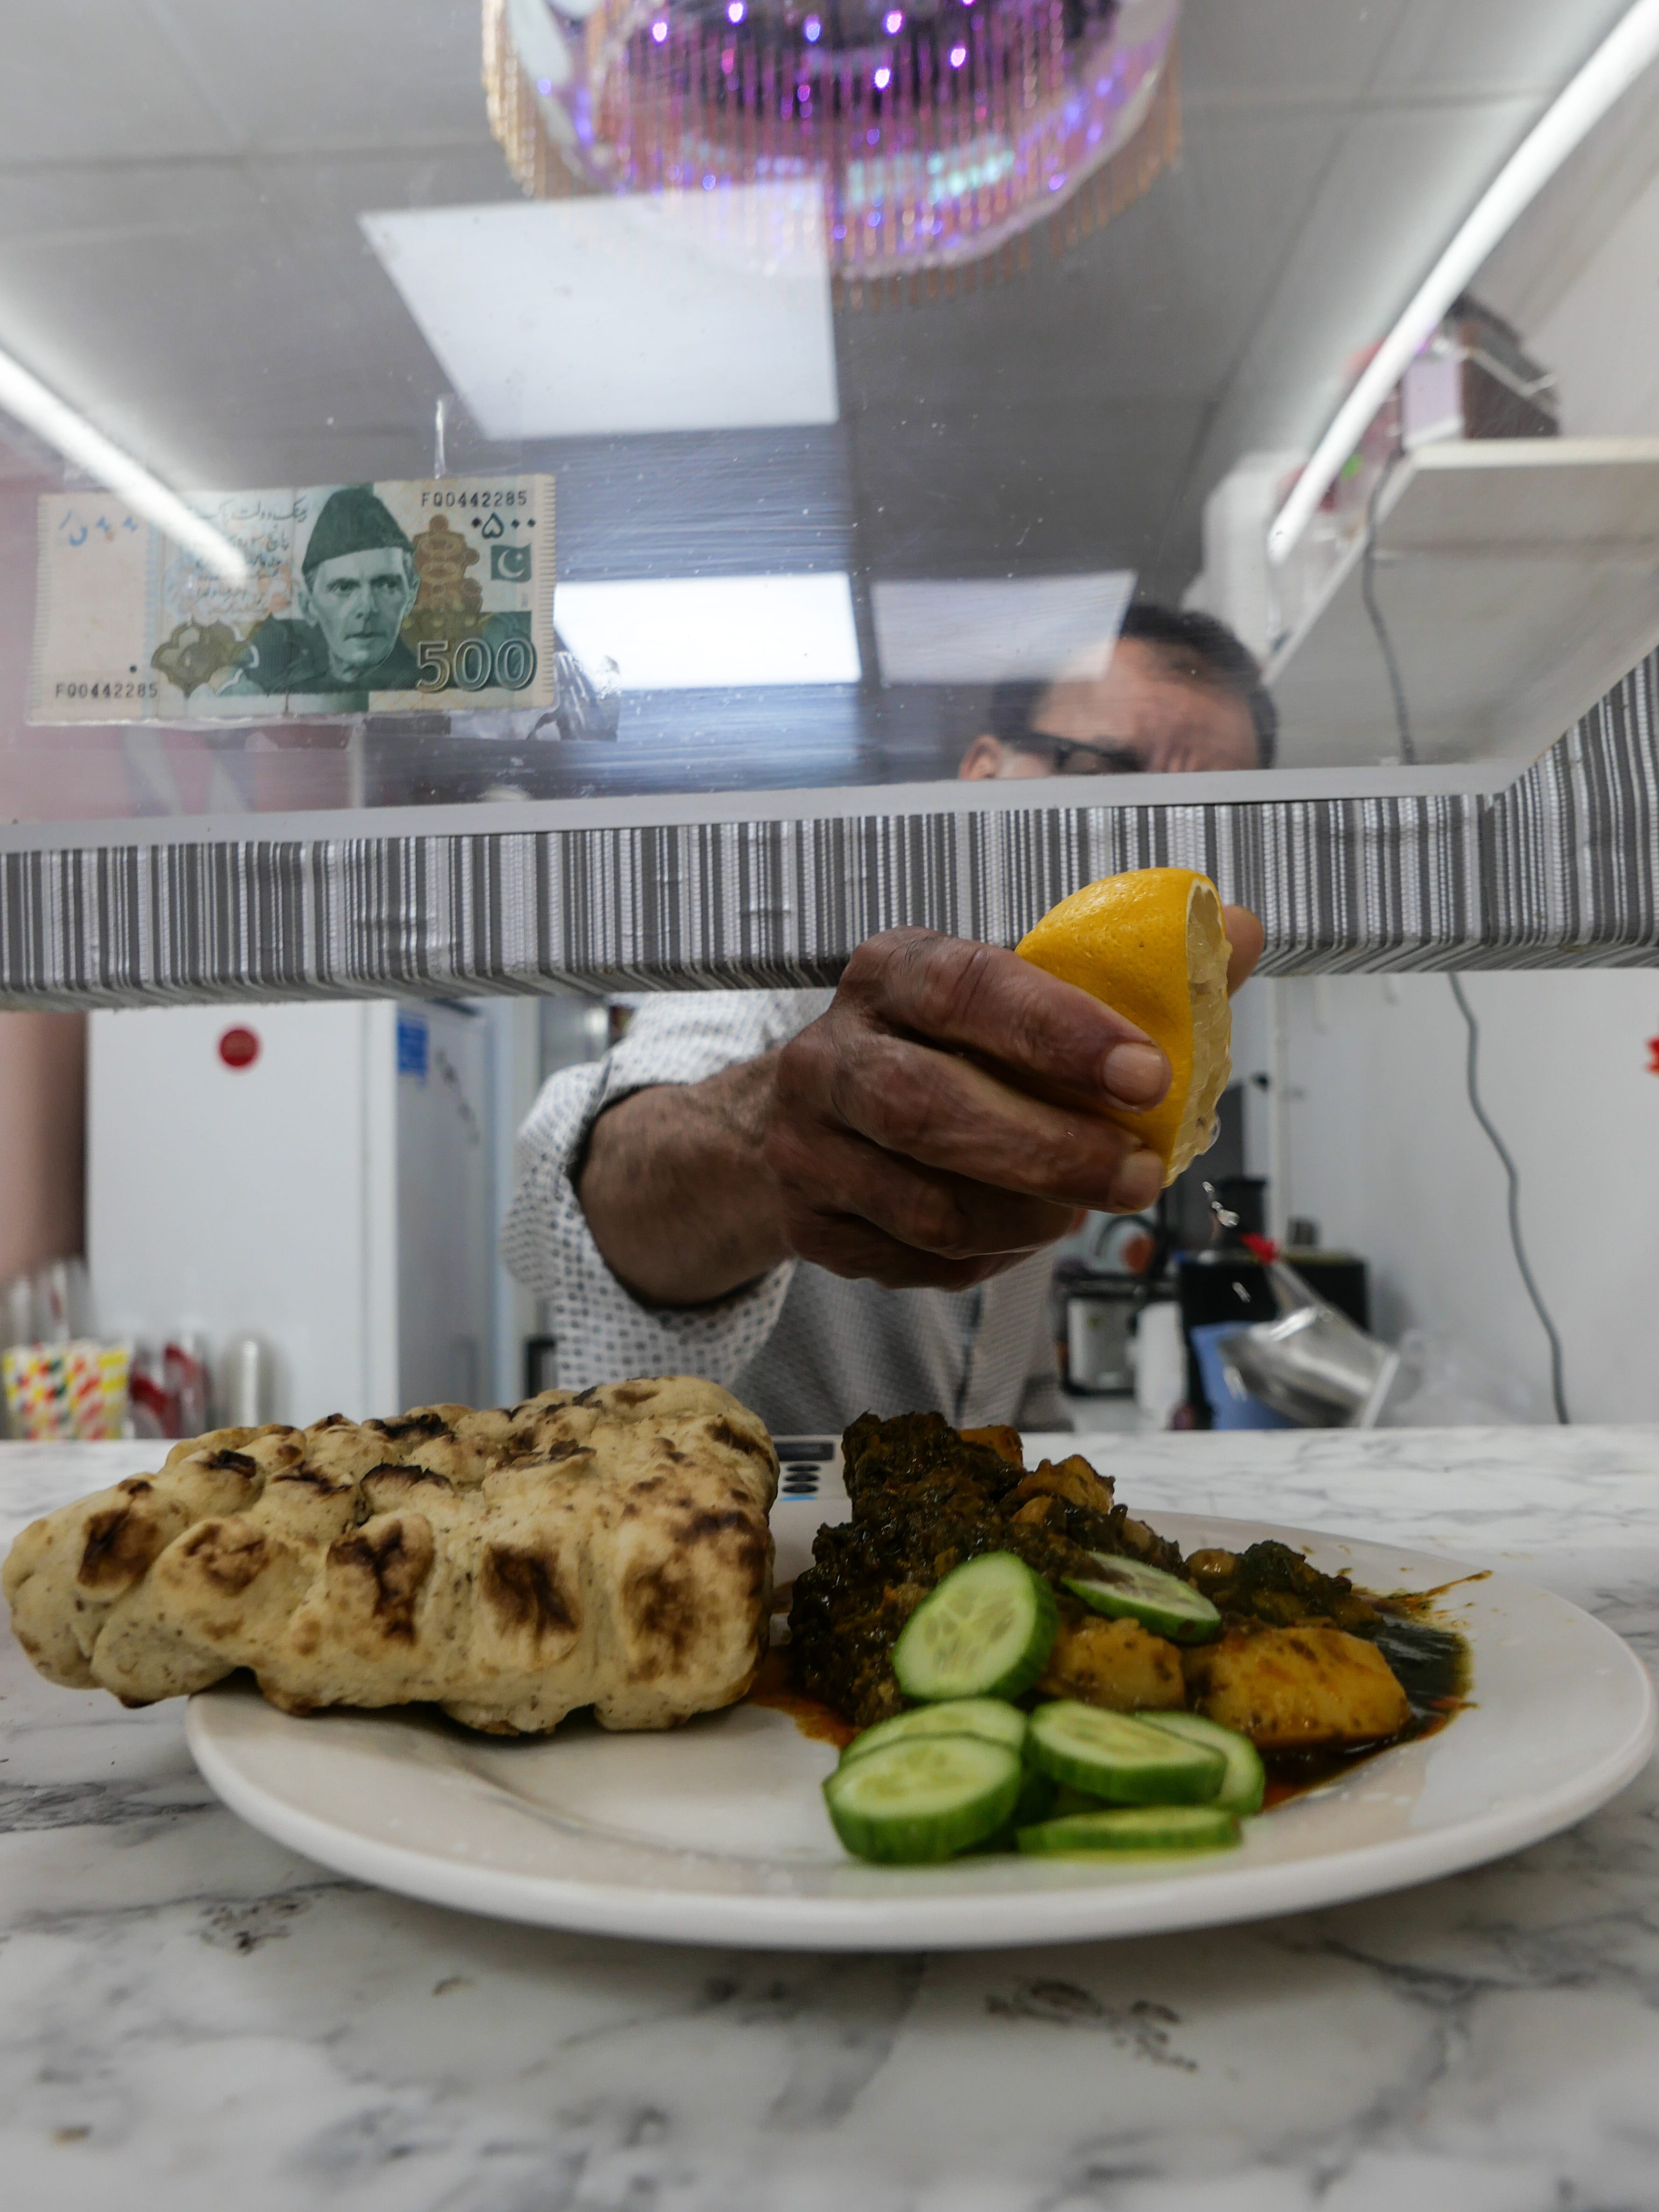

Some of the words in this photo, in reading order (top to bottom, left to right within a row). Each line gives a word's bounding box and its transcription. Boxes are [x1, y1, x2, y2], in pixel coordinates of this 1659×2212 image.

[421, 490, 527, 508] FQ0442285
[416, 638, 537, 694] 500
[55, 682, 158, 699] FQ0442285
